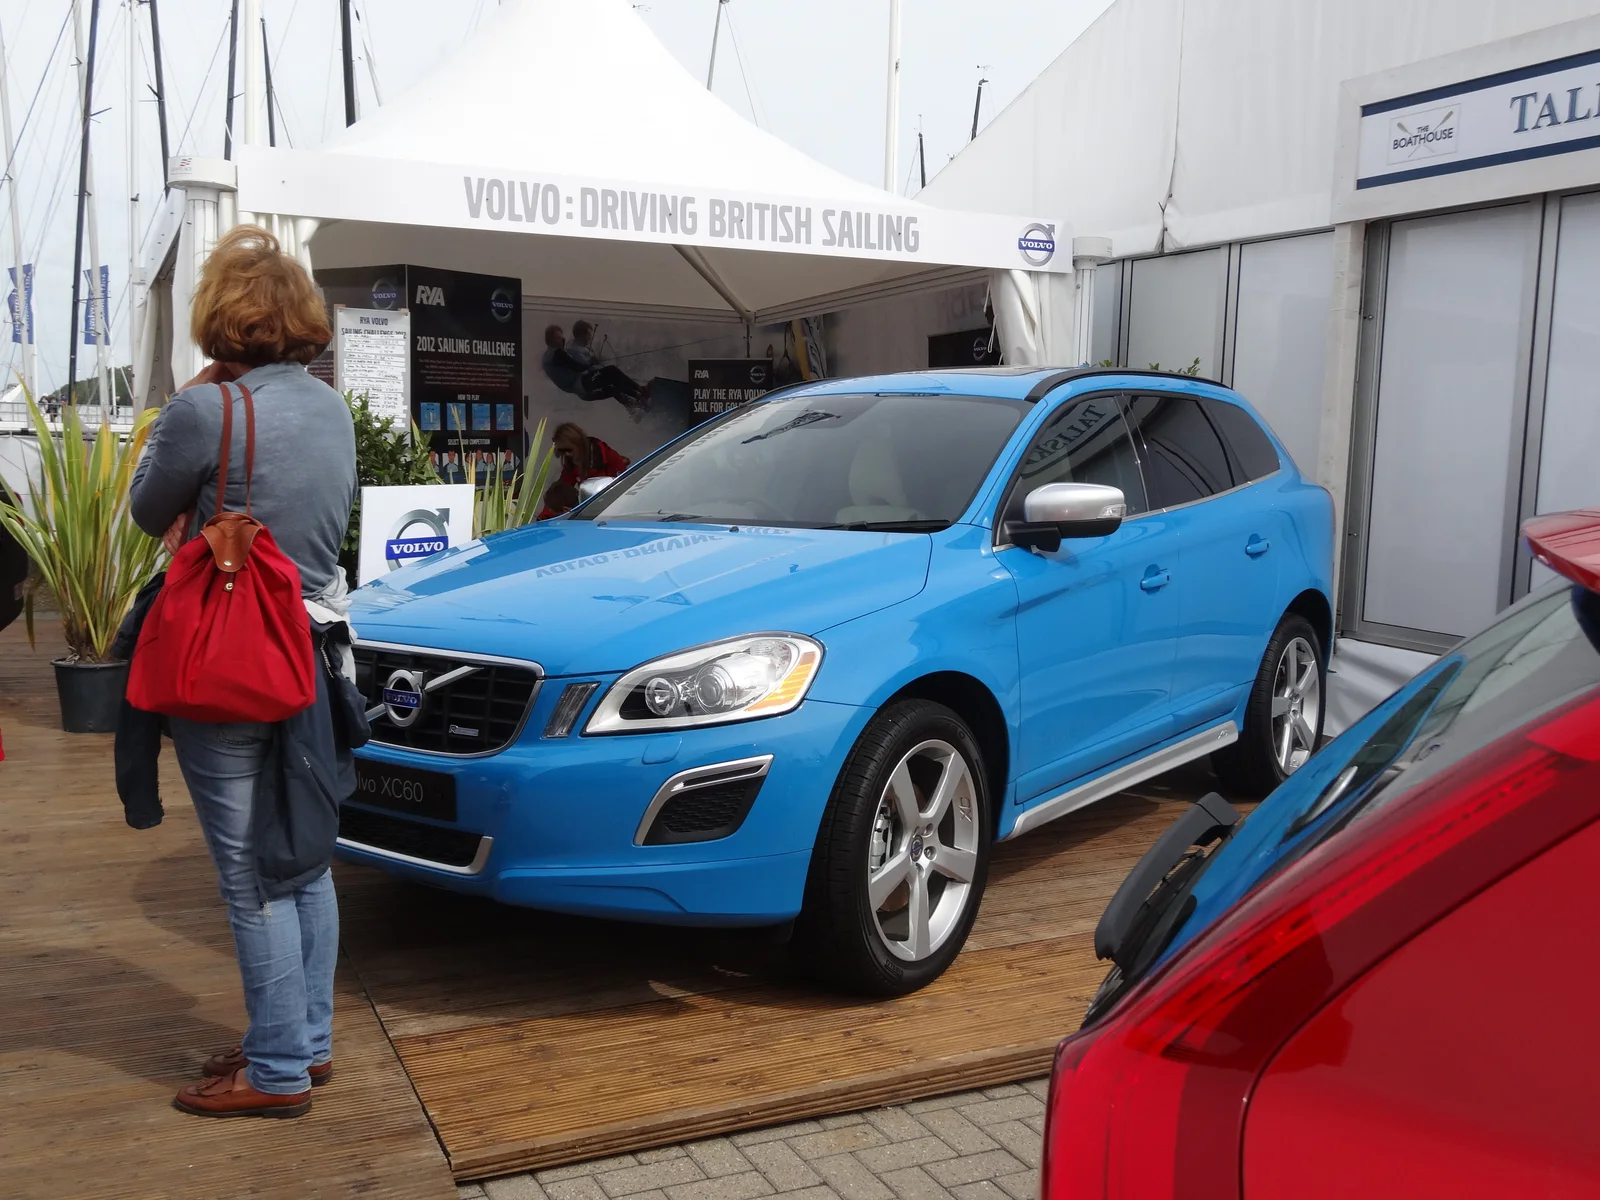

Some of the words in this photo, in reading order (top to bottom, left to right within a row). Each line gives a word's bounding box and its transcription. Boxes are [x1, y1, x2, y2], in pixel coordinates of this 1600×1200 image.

[1416, 125, 1430, 133] THE
[1393, 127, 1454, 150] BOATHOUSE
[580, 187, 698, 235] DRIVING
[709, 199, 812, 245] BRITISH
[822, 209, 920, 253] SAILING
[1020, 240, 1053, 250] VOLVO
[415, 285, 446, 306] RYA
[491, 301, 514, 309] VOLVO
[359, 316, 370, 325] RYA
[371, 317, 389, 326] VOLVO
[416, 335, 436, 352] 2012
[438, 337, 471, 355] SAILING
[472, 339, 516, 357] CHALLENGE
[694, 369, 710, 379] RYA
[693, 388, 711, 400] PLAY
[712, 388, 726, 400] THE
[728, 388, 742, 400] RYA
[693, 401, 709, 413] SAIL
[710, 401, 724, 413] FOR
[390, 541, 444, 555] VOLVO
[386, 693, 417, 704] VOLVO
[358, 771, 376, 793] lvo
[380, 775, 424, 803] XC60
